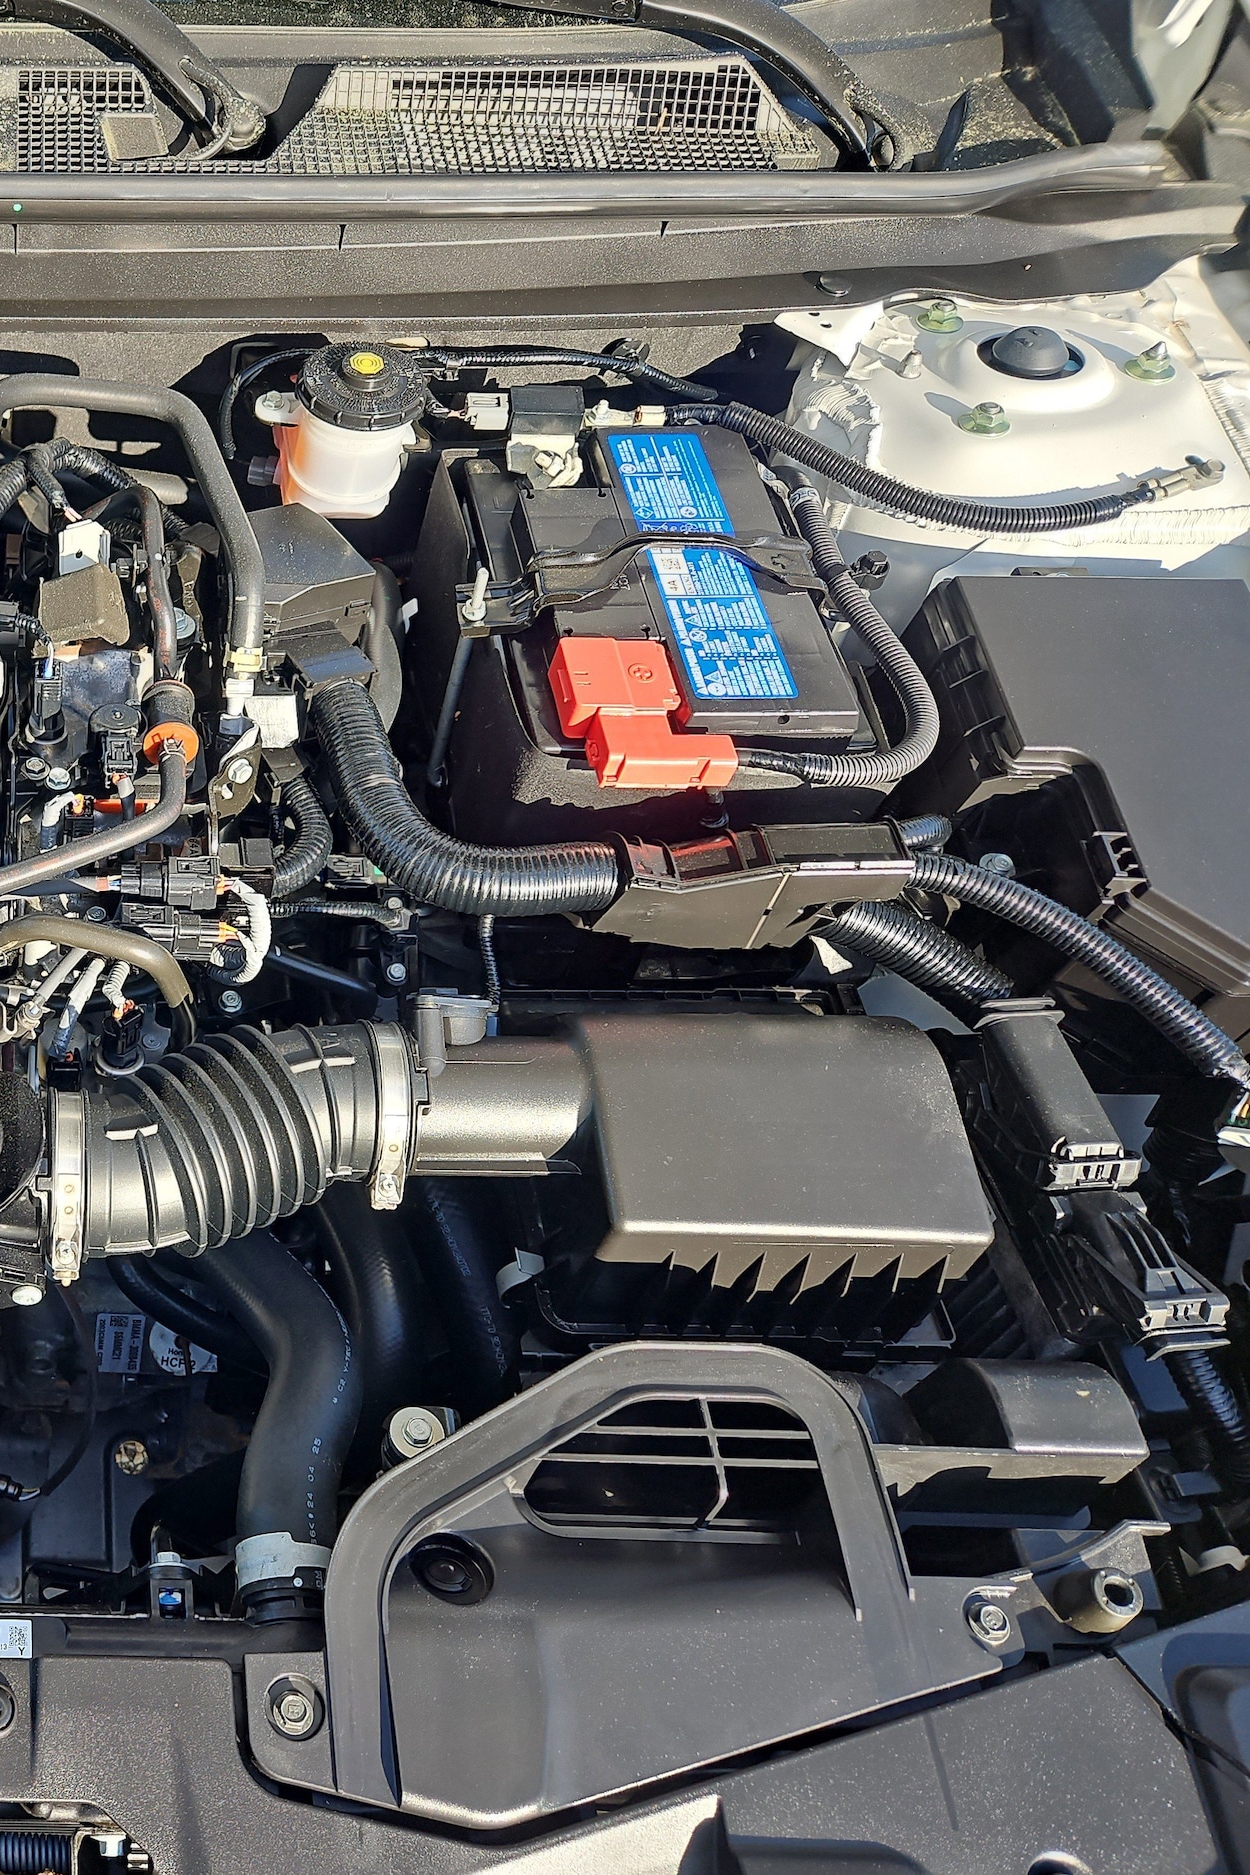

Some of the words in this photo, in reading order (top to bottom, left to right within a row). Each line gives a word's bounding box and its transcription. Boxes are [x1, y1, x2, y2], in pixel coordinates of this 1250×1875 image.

[311, 1437, 323, 1455] 25
[307, 1465, 316, 1482] 04
[306, 1492, 315, 1509] 24
[18, 1647, 26, 1655] Y
